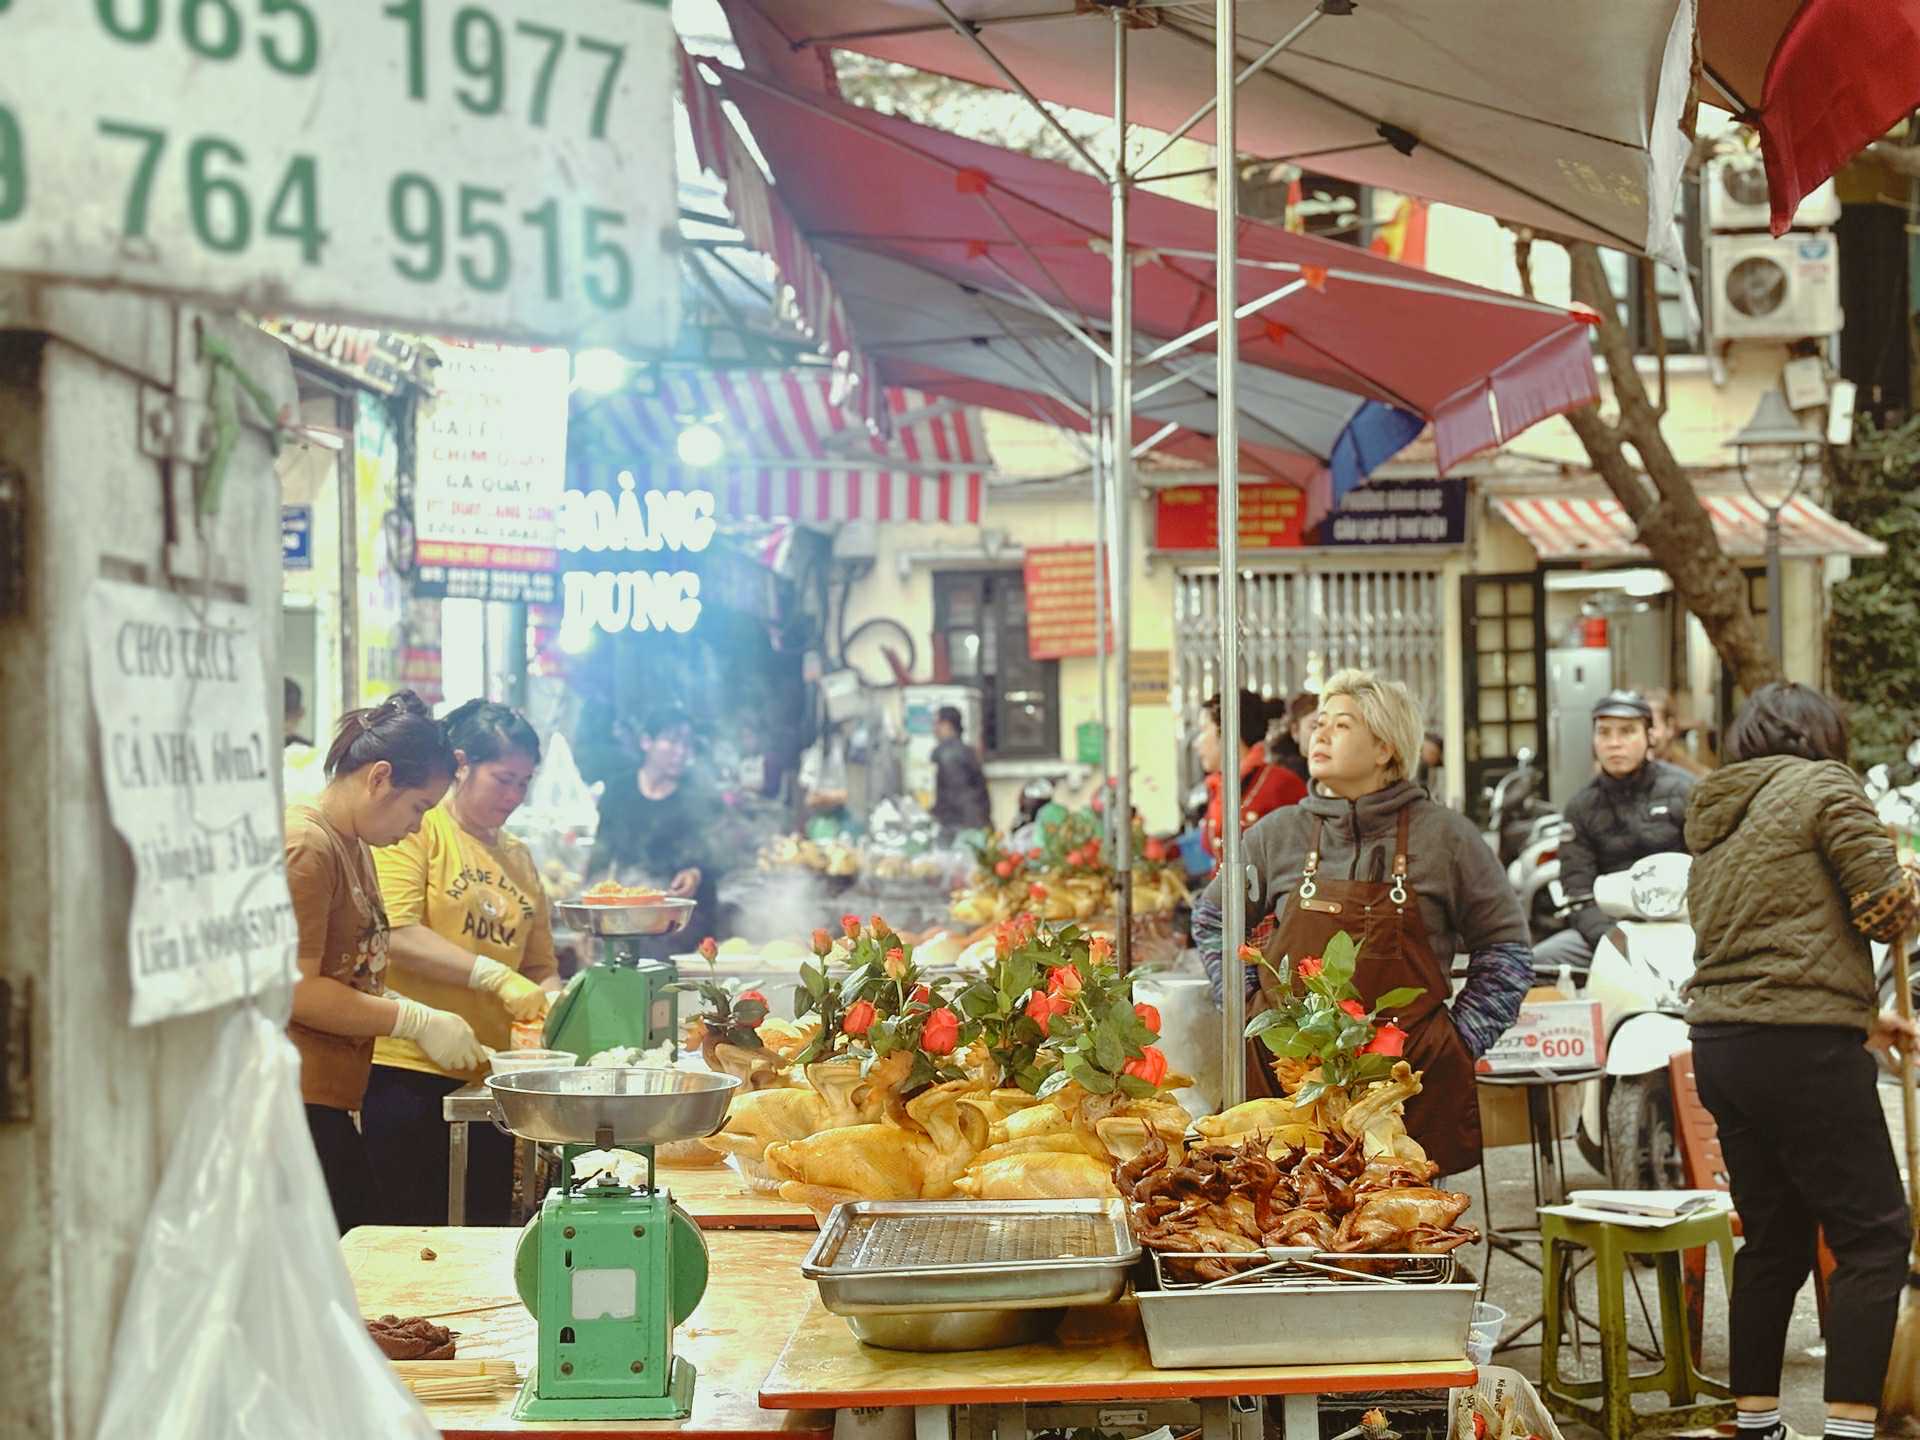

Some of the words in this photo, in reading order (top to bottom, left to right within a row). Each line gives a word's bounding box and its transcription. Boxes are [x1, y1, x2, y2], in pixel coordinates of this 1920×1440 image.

[382, 0, 628, 140] 1977
[97, 116, 329, 267] 764
[387, 171, 635, 312] 9515
[462, 911, 516, 946] ADLV
[1541, 1038, 1585, 1057] 600
